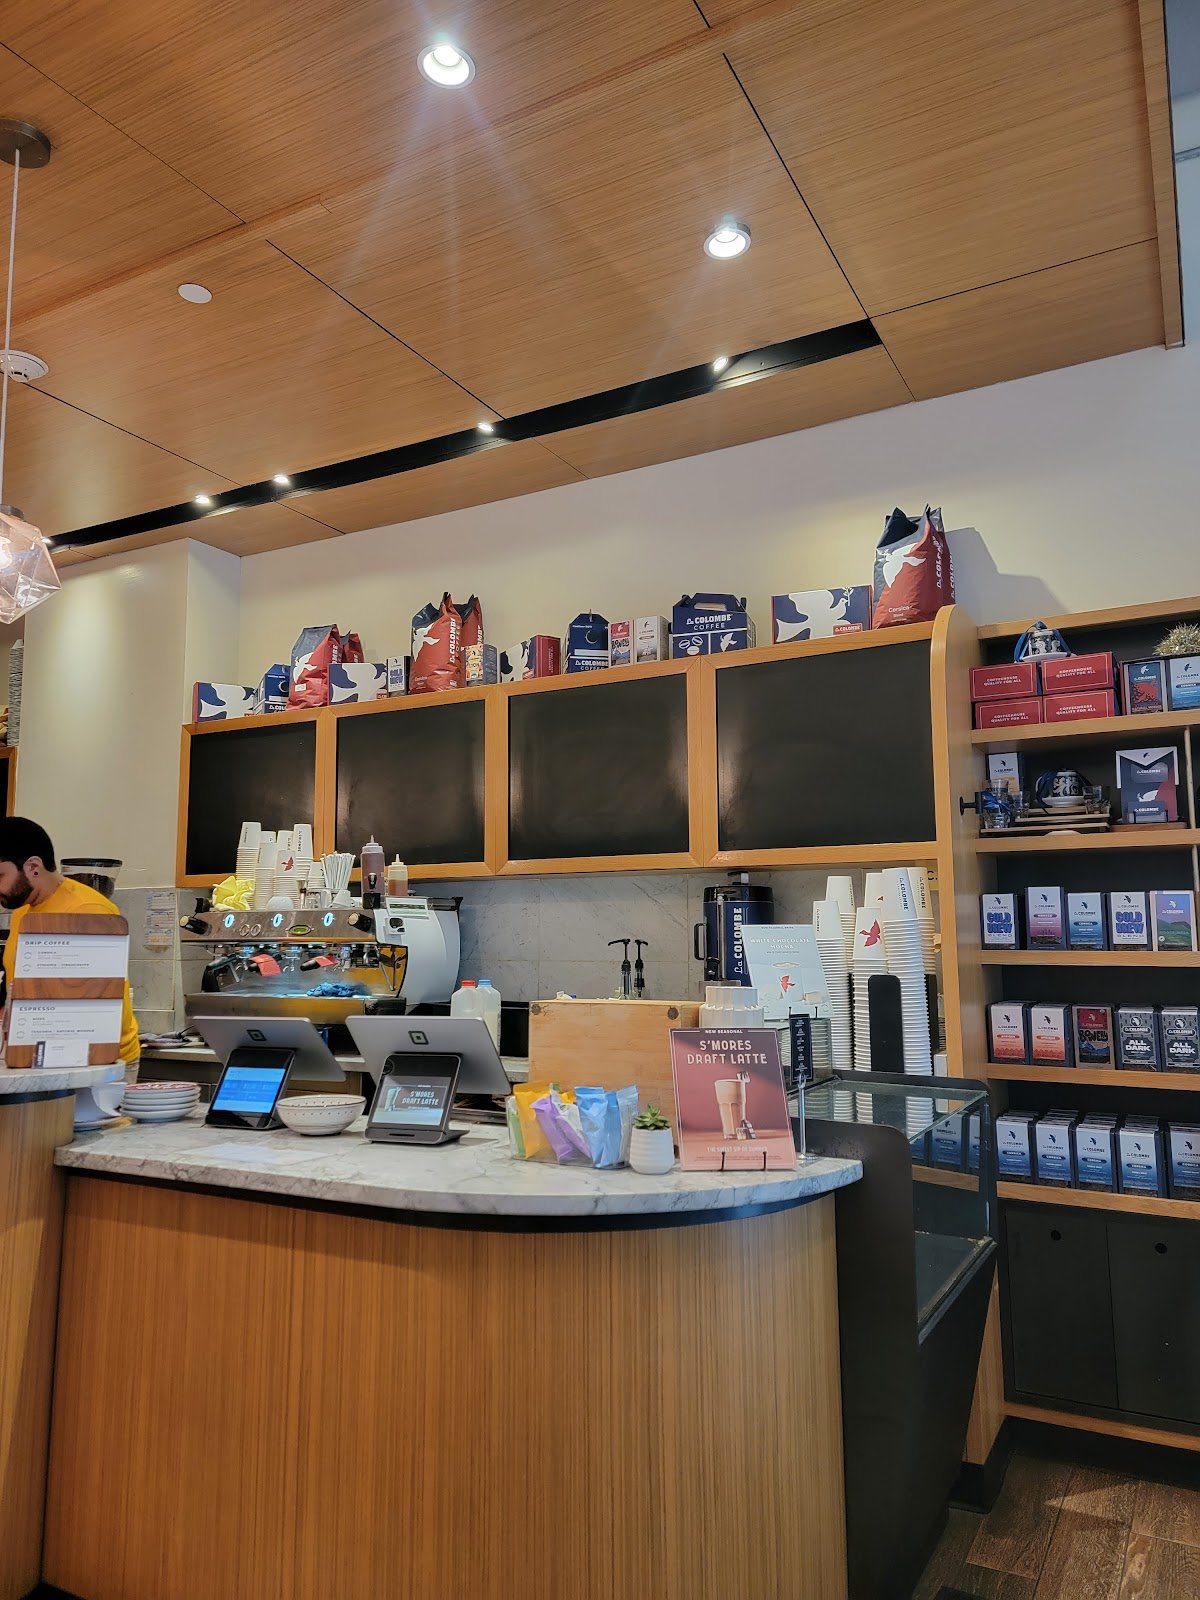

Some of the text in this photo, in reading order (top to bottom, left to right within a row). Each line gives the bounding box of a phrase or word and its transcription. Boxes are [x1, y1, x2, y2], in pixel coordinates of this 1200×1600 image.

[695, 614, 732, 624] COLOMBE
[900, 883, 909, 910] COLOMBE
[1115, 911, 1143, 922] COLD
[734, 908, 743, 974] La COLOMBE
[700, 1040, 752, 1051] S'MORES
[688, 1053, 768, 1064] DRAFT LATTE
